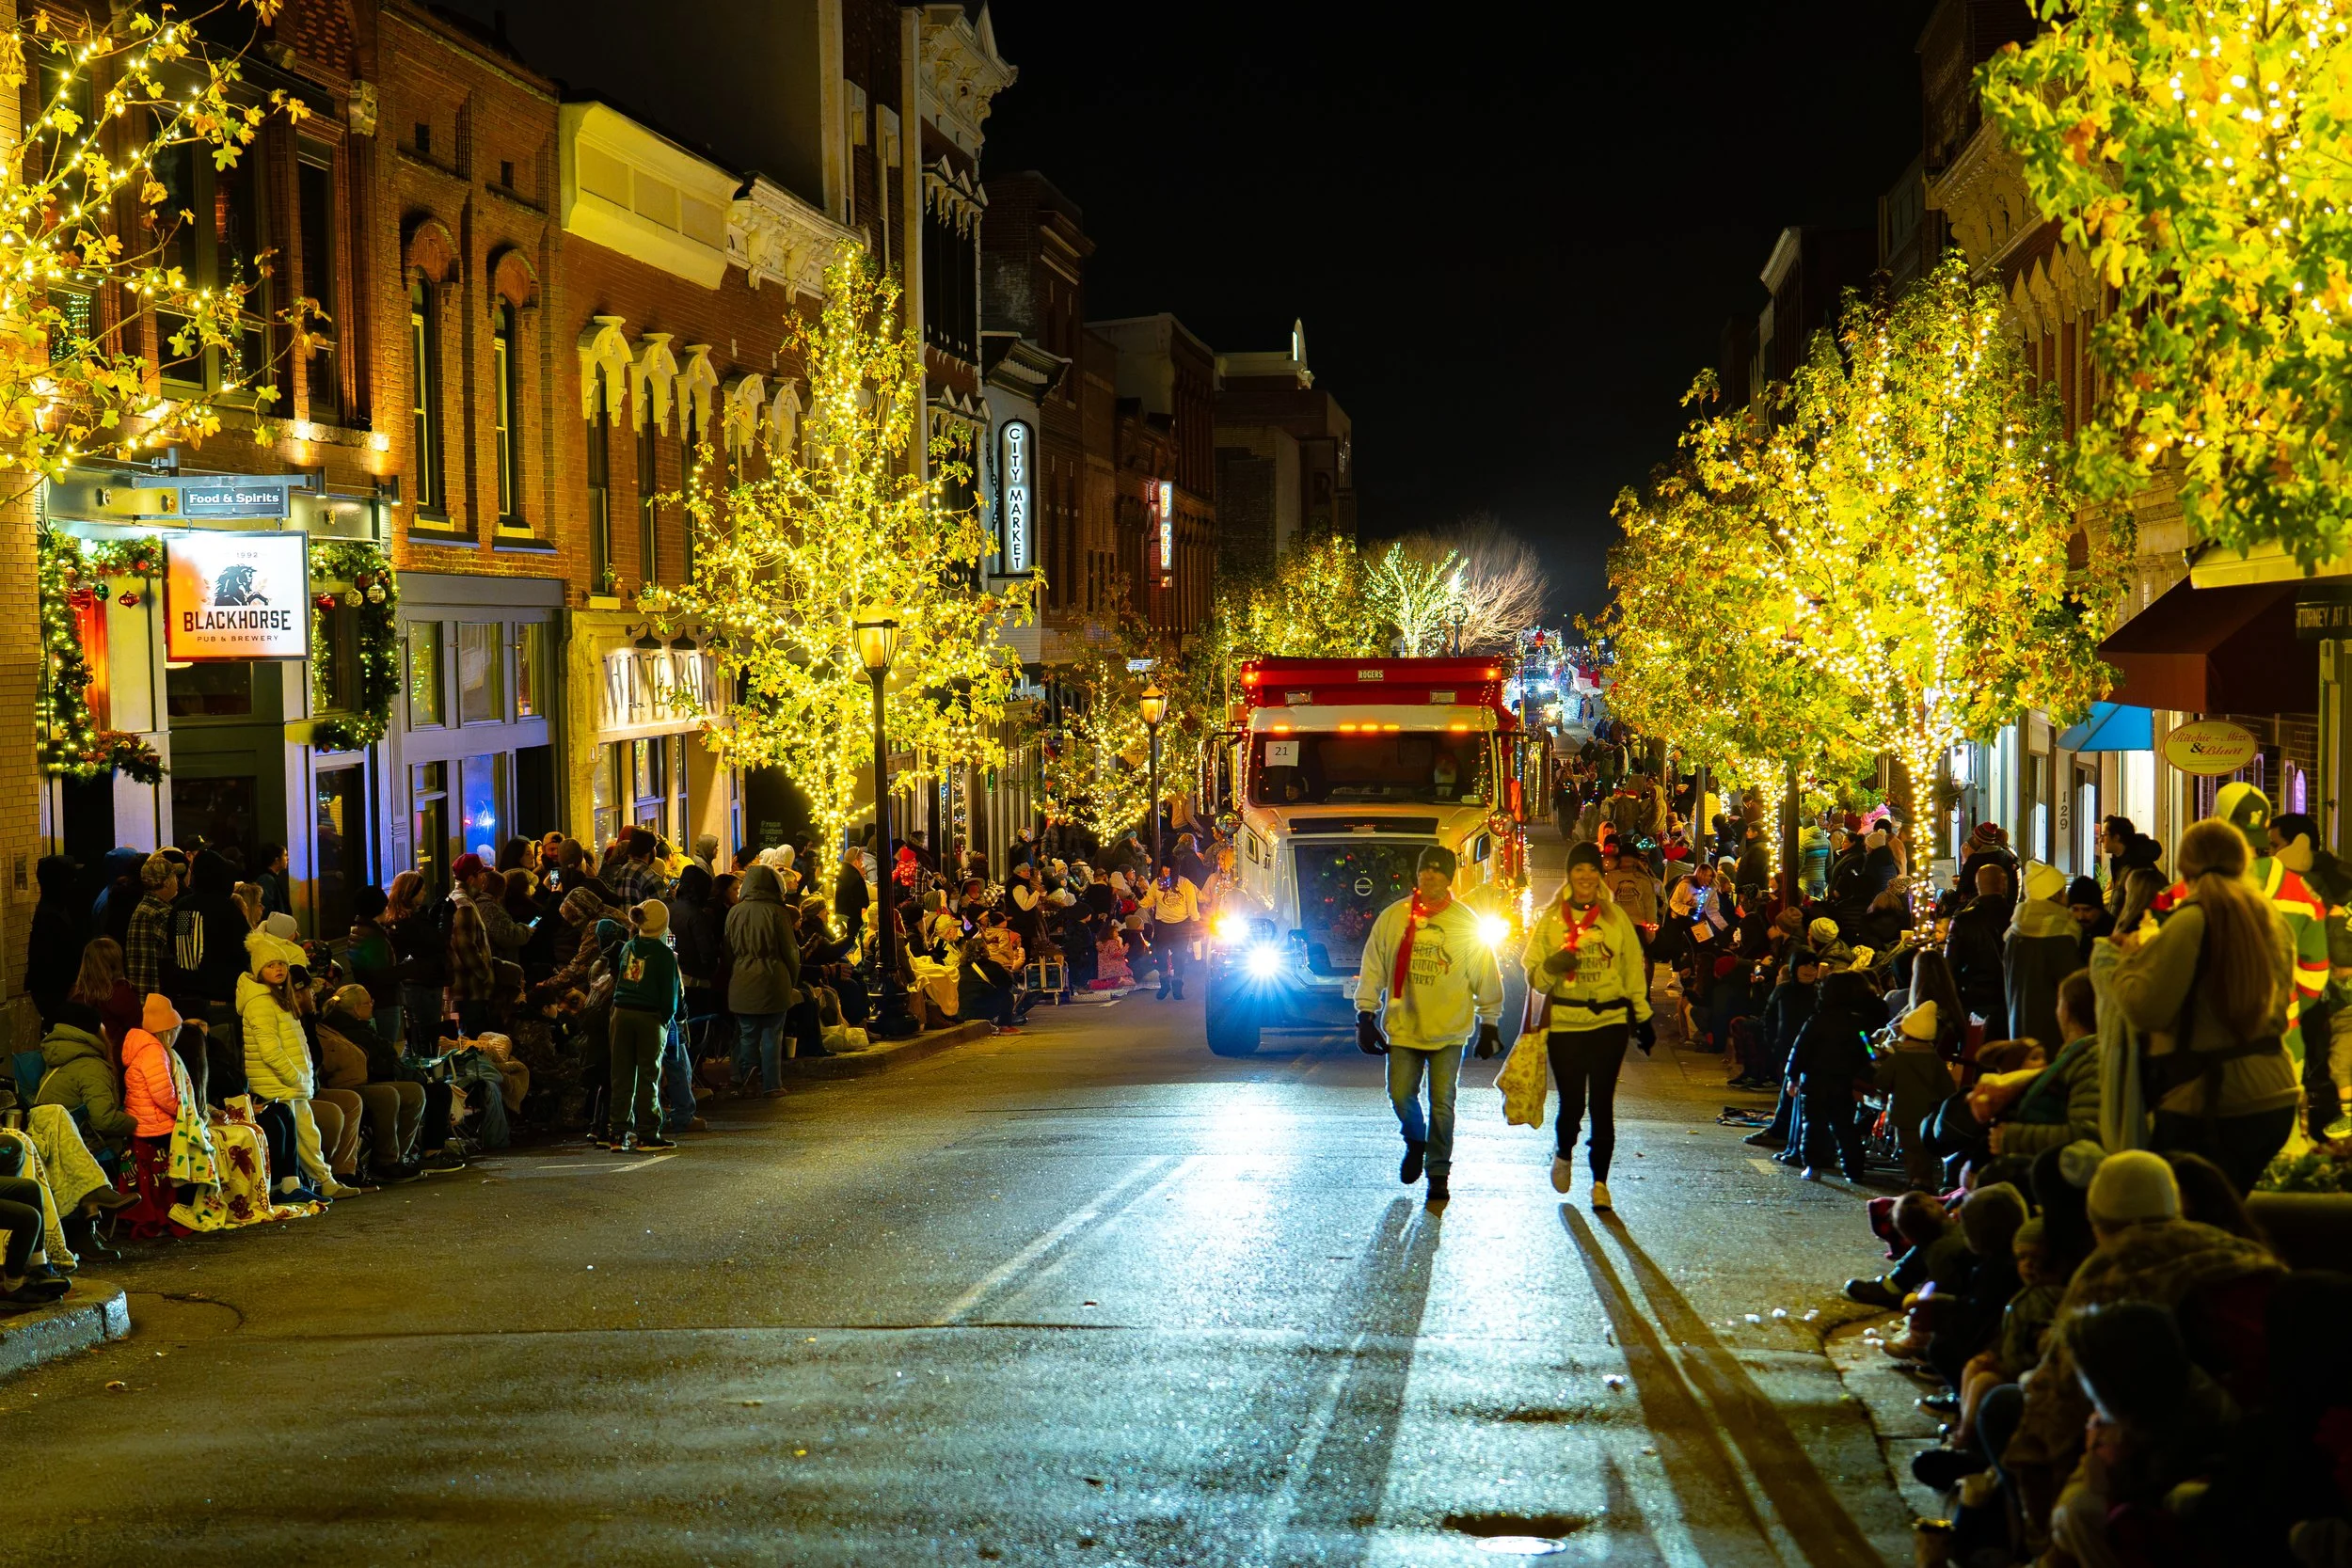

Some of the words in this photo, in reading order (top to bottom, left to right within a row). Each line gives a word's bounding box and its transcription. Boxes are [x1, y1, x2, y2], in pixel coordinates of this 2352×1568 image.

[1009, 428, 1021, 481] CITY
[189, 493, 220, 503] Food
[223, 493, 232, 503] &
[236, 493, 279, 504] Spirits
[1009, 489, 1023, 569] MARKET
[183, 610, 292, 631] BLACKHORSE
[2333, 606, 2344, 626] AT
[1275, 747, 1288, 755] 21
[2190, 742, 2202, 753] &
